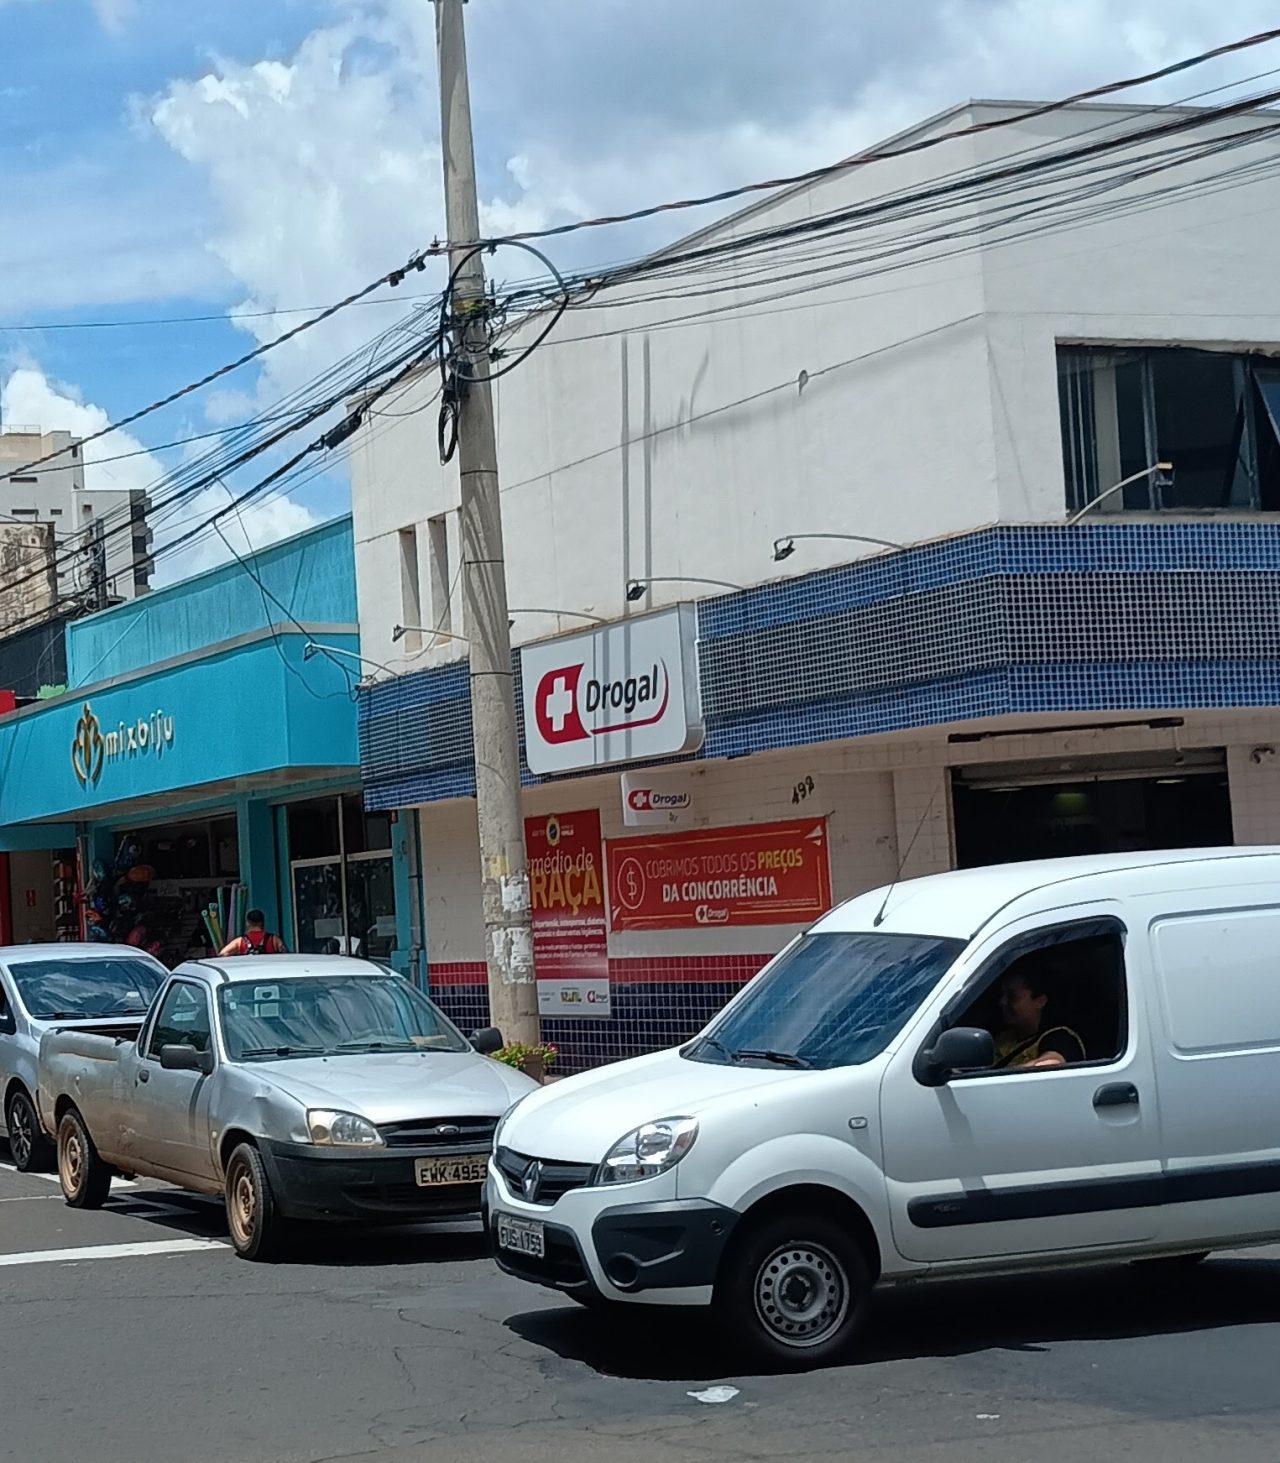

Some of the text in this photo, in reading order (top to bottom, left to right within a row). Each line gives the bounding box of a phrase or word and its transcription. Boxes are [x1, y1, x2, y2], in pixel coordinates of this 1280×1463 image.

[586, 664, 658, 714] Drogal
[105, 709, 173, 756] mixbiju
[653, 793, 687, 805] Drogal
[576, 847, 594, 872] de
[646, 848, 803, 879] COBRIMOS TODOS OS PREÇOS
[531, 865, 601, 916] RAÇA
[662, 874, 778, 903] DA CONCORRÊNCIA
